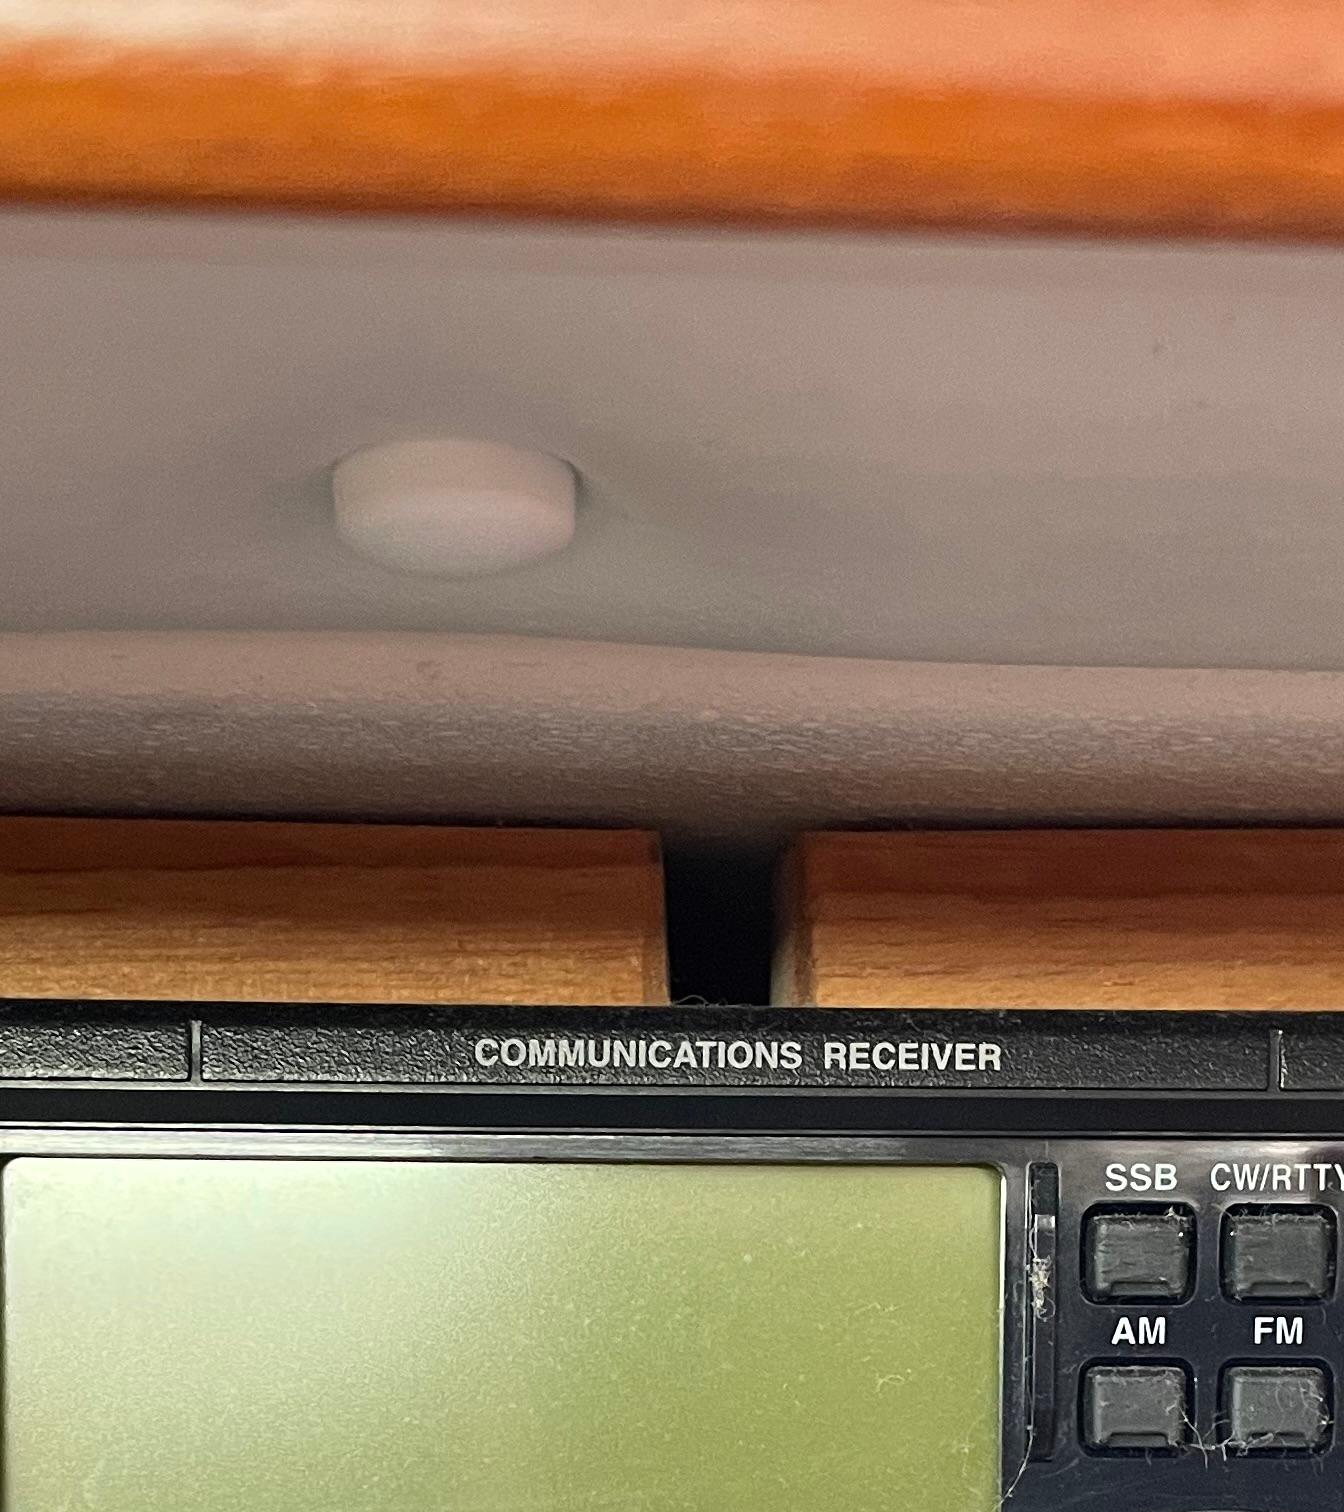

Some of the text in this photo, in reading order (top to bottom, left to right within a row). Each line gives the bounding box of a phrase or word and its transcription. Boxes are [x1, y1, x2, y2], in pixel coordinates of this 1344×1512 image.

[474, 1038, 1002, 1072] COMMUNICATIONS RECEIVER
[1104, 1163, 1178, 1192] SSB
[1111, 1316, 1167, 1346] AM
[1253, 1316, 1304, 1346] FM
